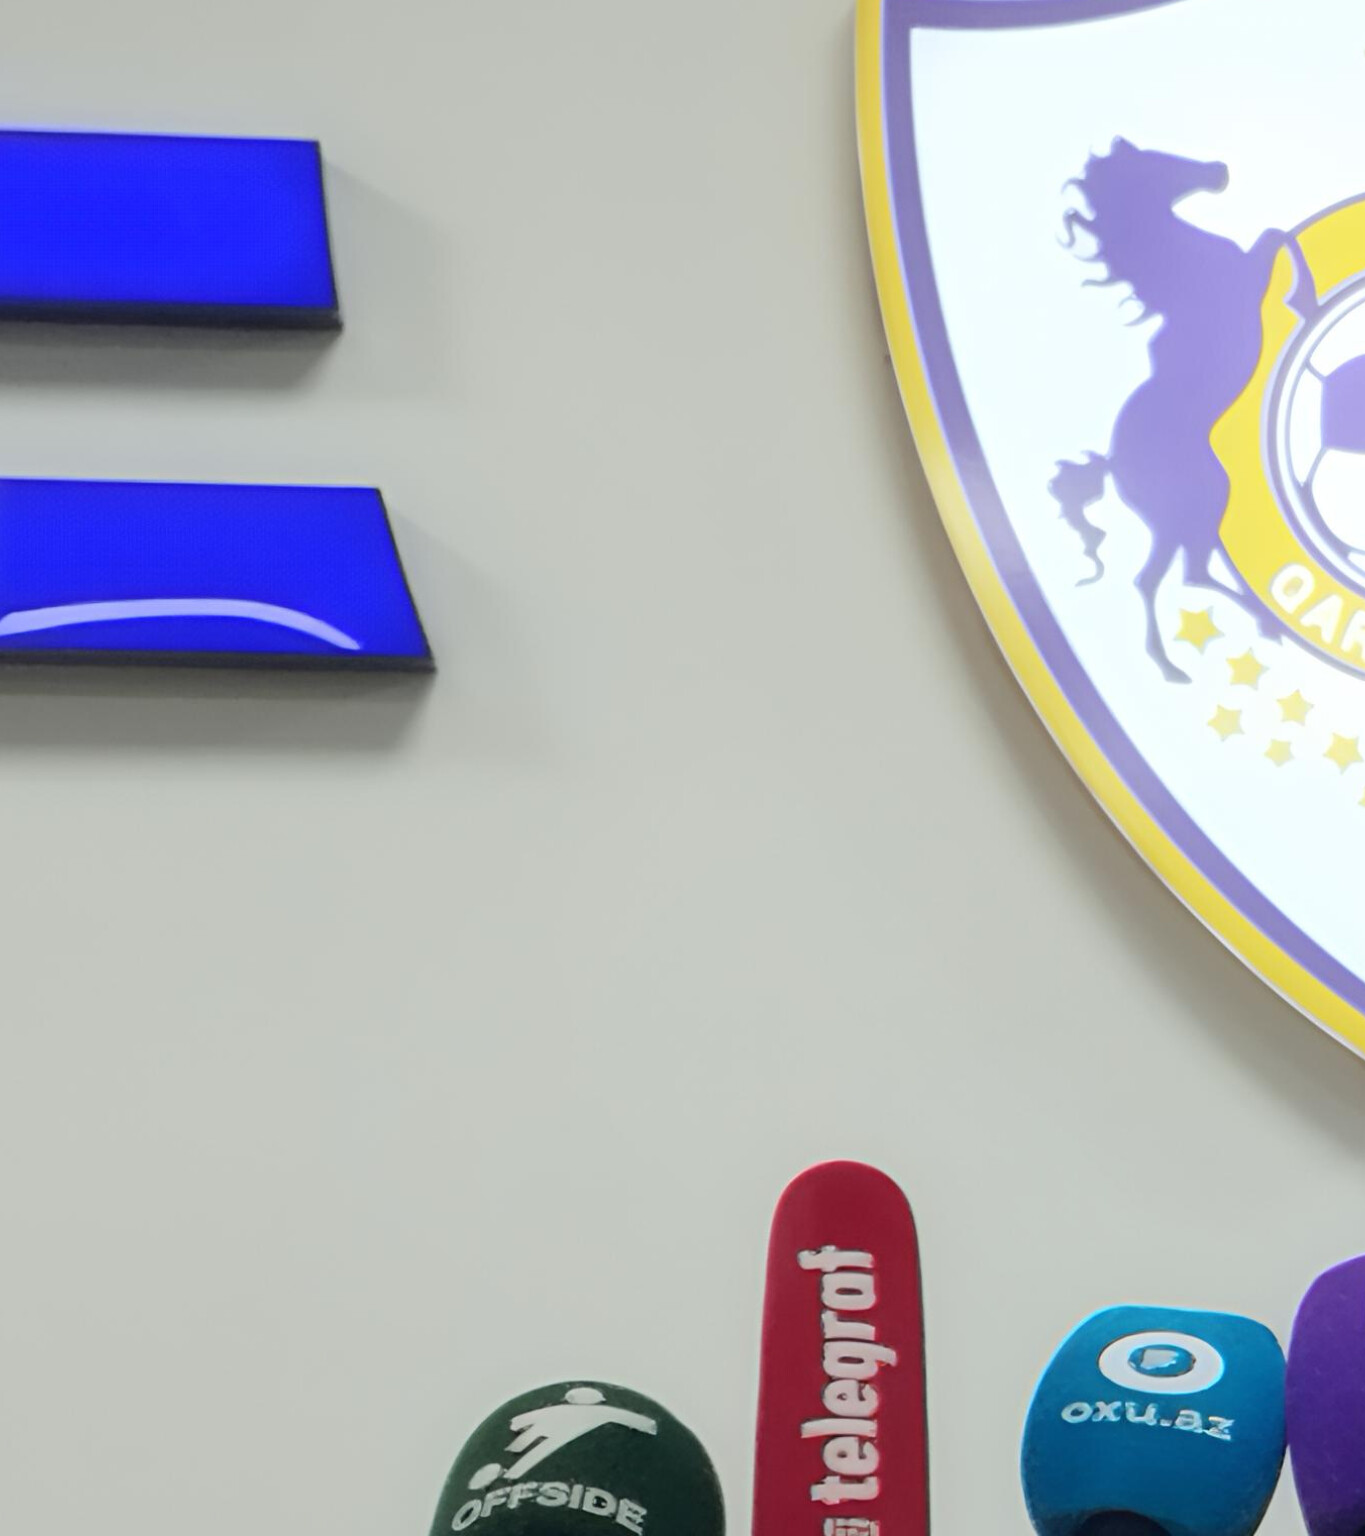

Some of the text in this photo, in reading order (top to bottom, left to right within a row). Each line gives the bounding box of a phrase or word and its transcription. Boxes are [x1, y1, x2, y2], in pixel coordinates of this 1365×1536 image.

[799, 1244, 899, 1504] telegraf
[1060, 1400, 1236, 1442] oxu.az
[450, 1480, 649, 1536] OFFSIDE
